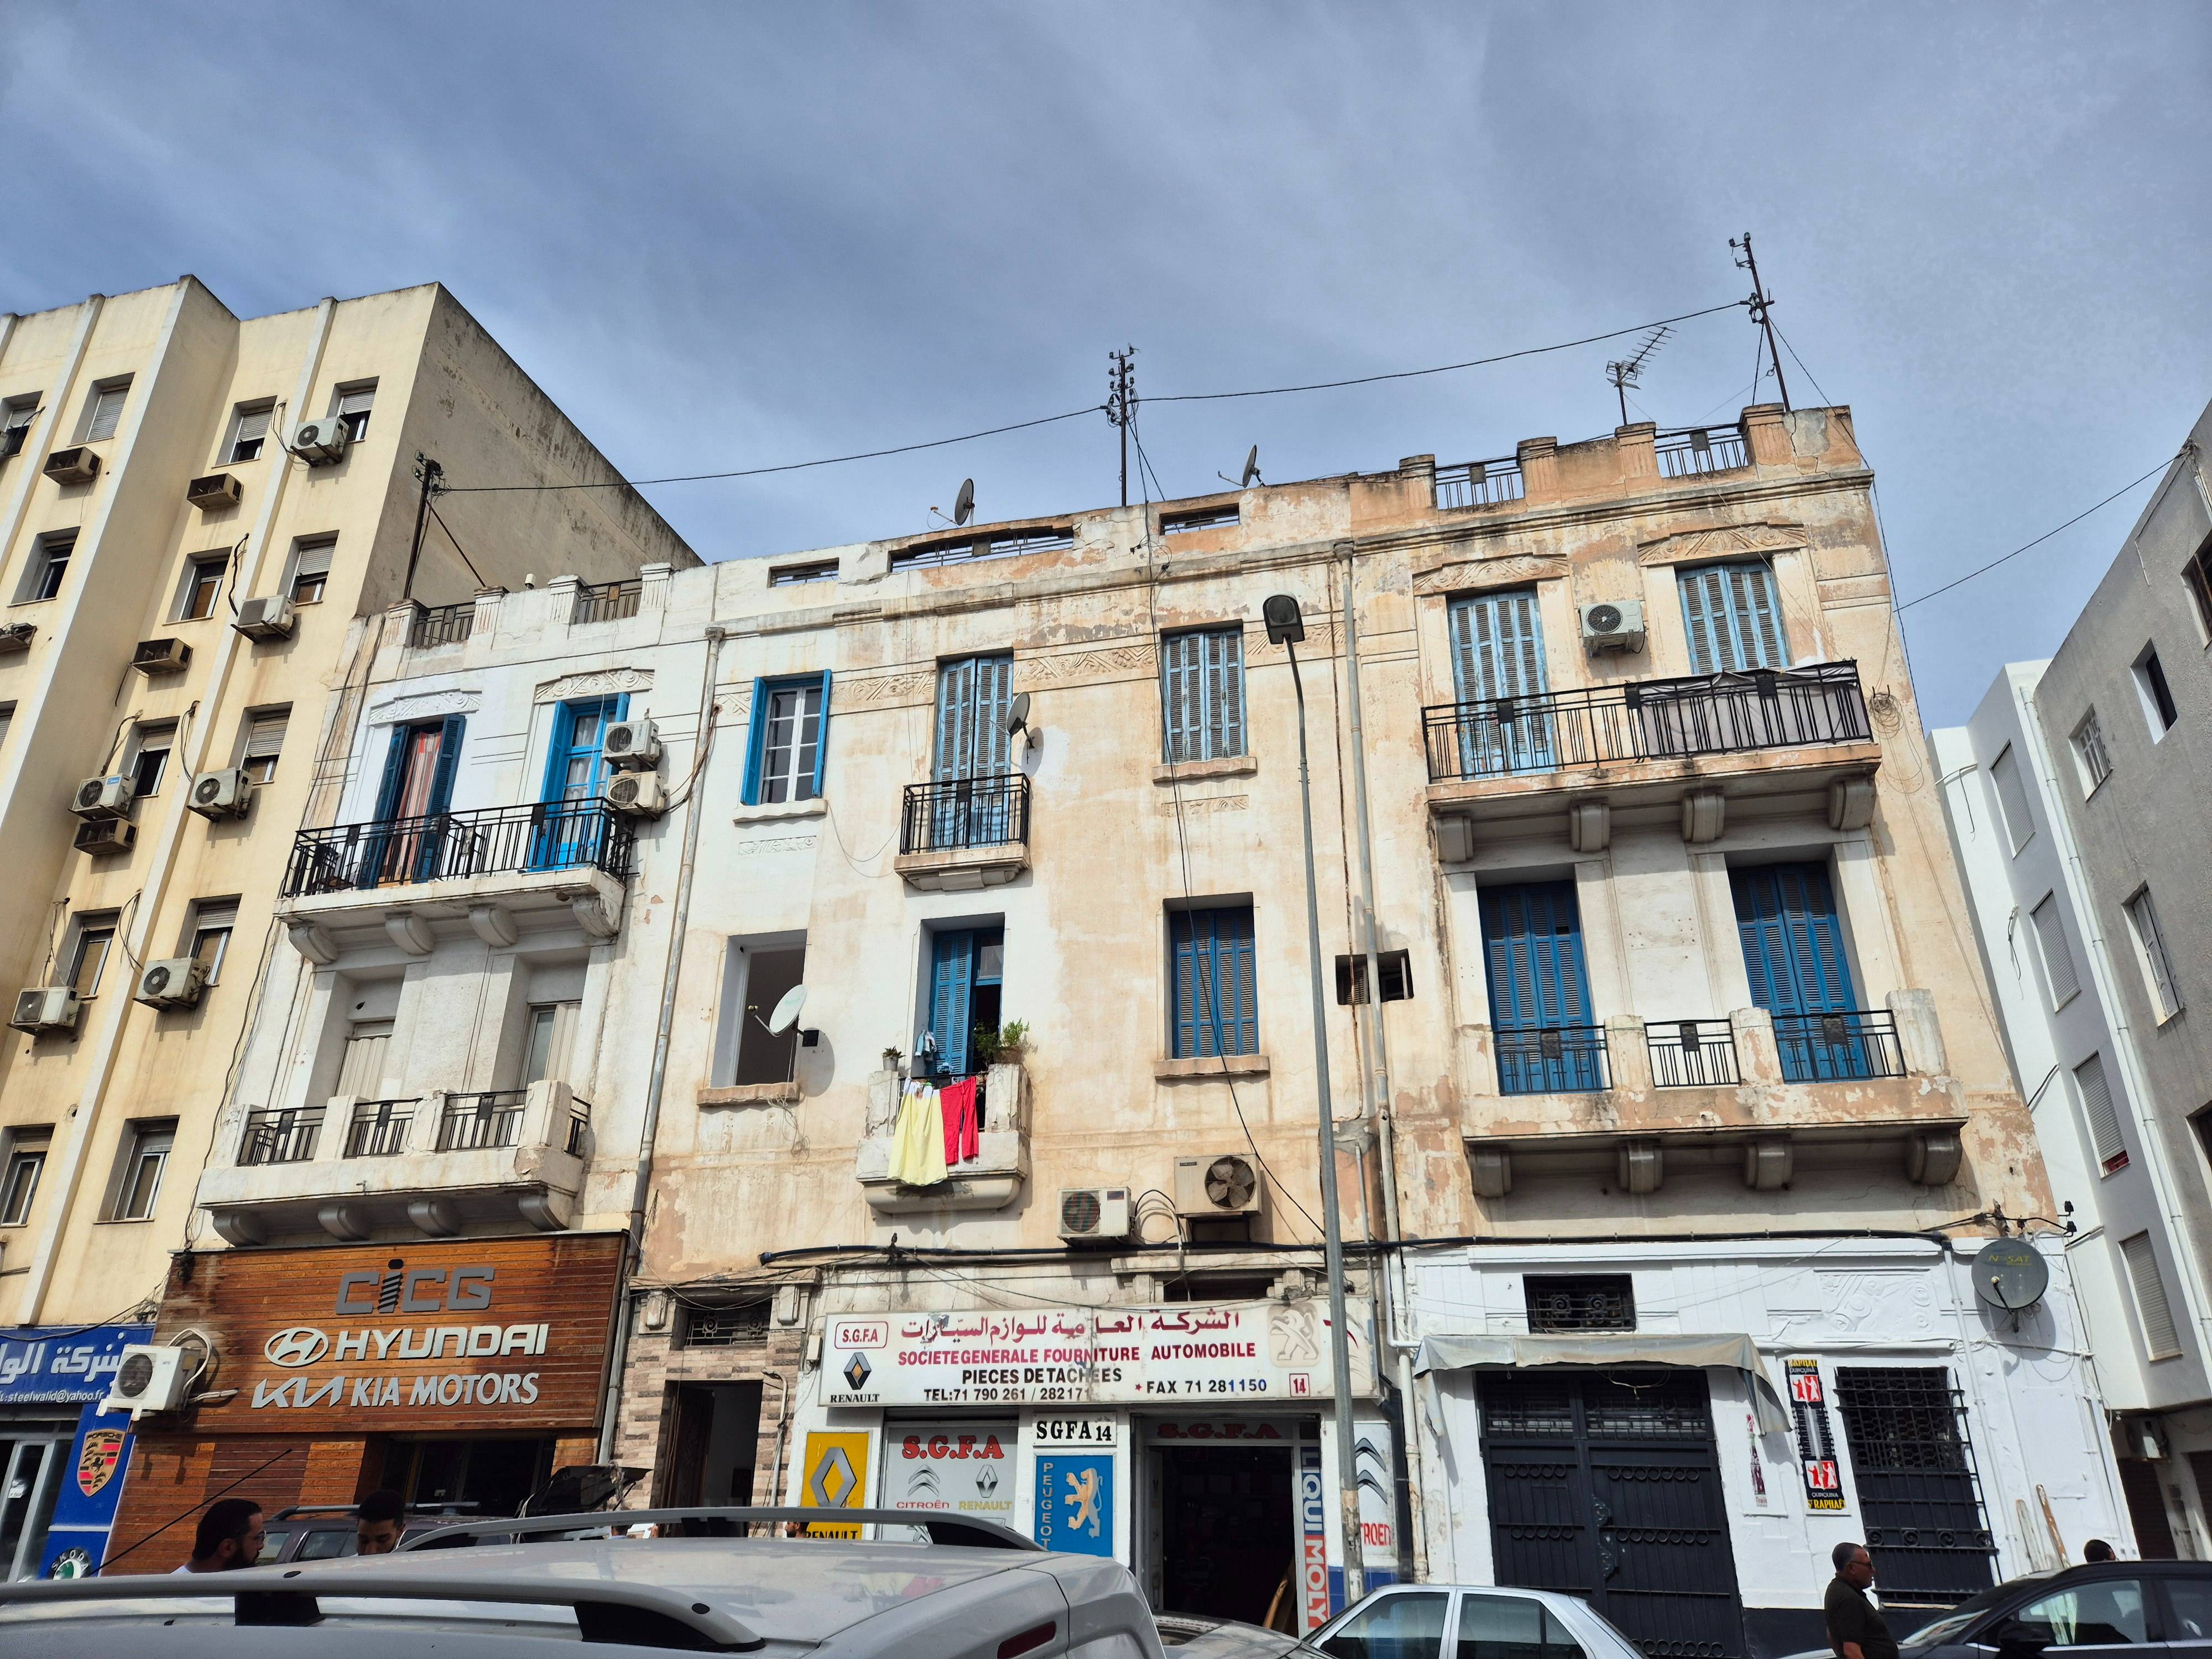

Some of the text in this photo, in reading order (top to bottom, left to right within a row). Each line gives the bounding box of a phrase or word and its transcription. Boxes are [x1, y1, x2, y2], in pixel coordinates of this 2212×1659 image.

[335, 1324, 549, 1361] HYUNDAI
[842, 1329, 878, 1343] S.G.F.A
[898, 1343, 1256, 1365] SOCIETE GENERALE FOURNITURE AUTOMOBILE
[962, 1369, 1019, 1384] PIECES
[350, 1377, 400, 1407] KIA
[409, 1373, 539, 1406] MOTORS
[973, 1387, 998, 1401] 790
[1002, 1387, 1025, 1400] 261
[1146, 1381, 1177, 1394] FAX
[1185, 1380, 1201, 1393] 71
[1293, 1378, 1306, 1394] 14
[830, 1394, 880, 1403] RENAULT
[1036, 1421, 1112, 1441] SGFA 14
[1157, 1423, 1282, 1439] S.G.F.A
[902, 1434, 1004, 1459] S.G.F.A
[1301, 1452, 1323, 1531] LIQUI
[958, 1500, 1012, 1510] RENAULT
[1040, 1462, 1053, 1550] PEUGEOT
[1305, 1539, 1327, 1624] MOLY
